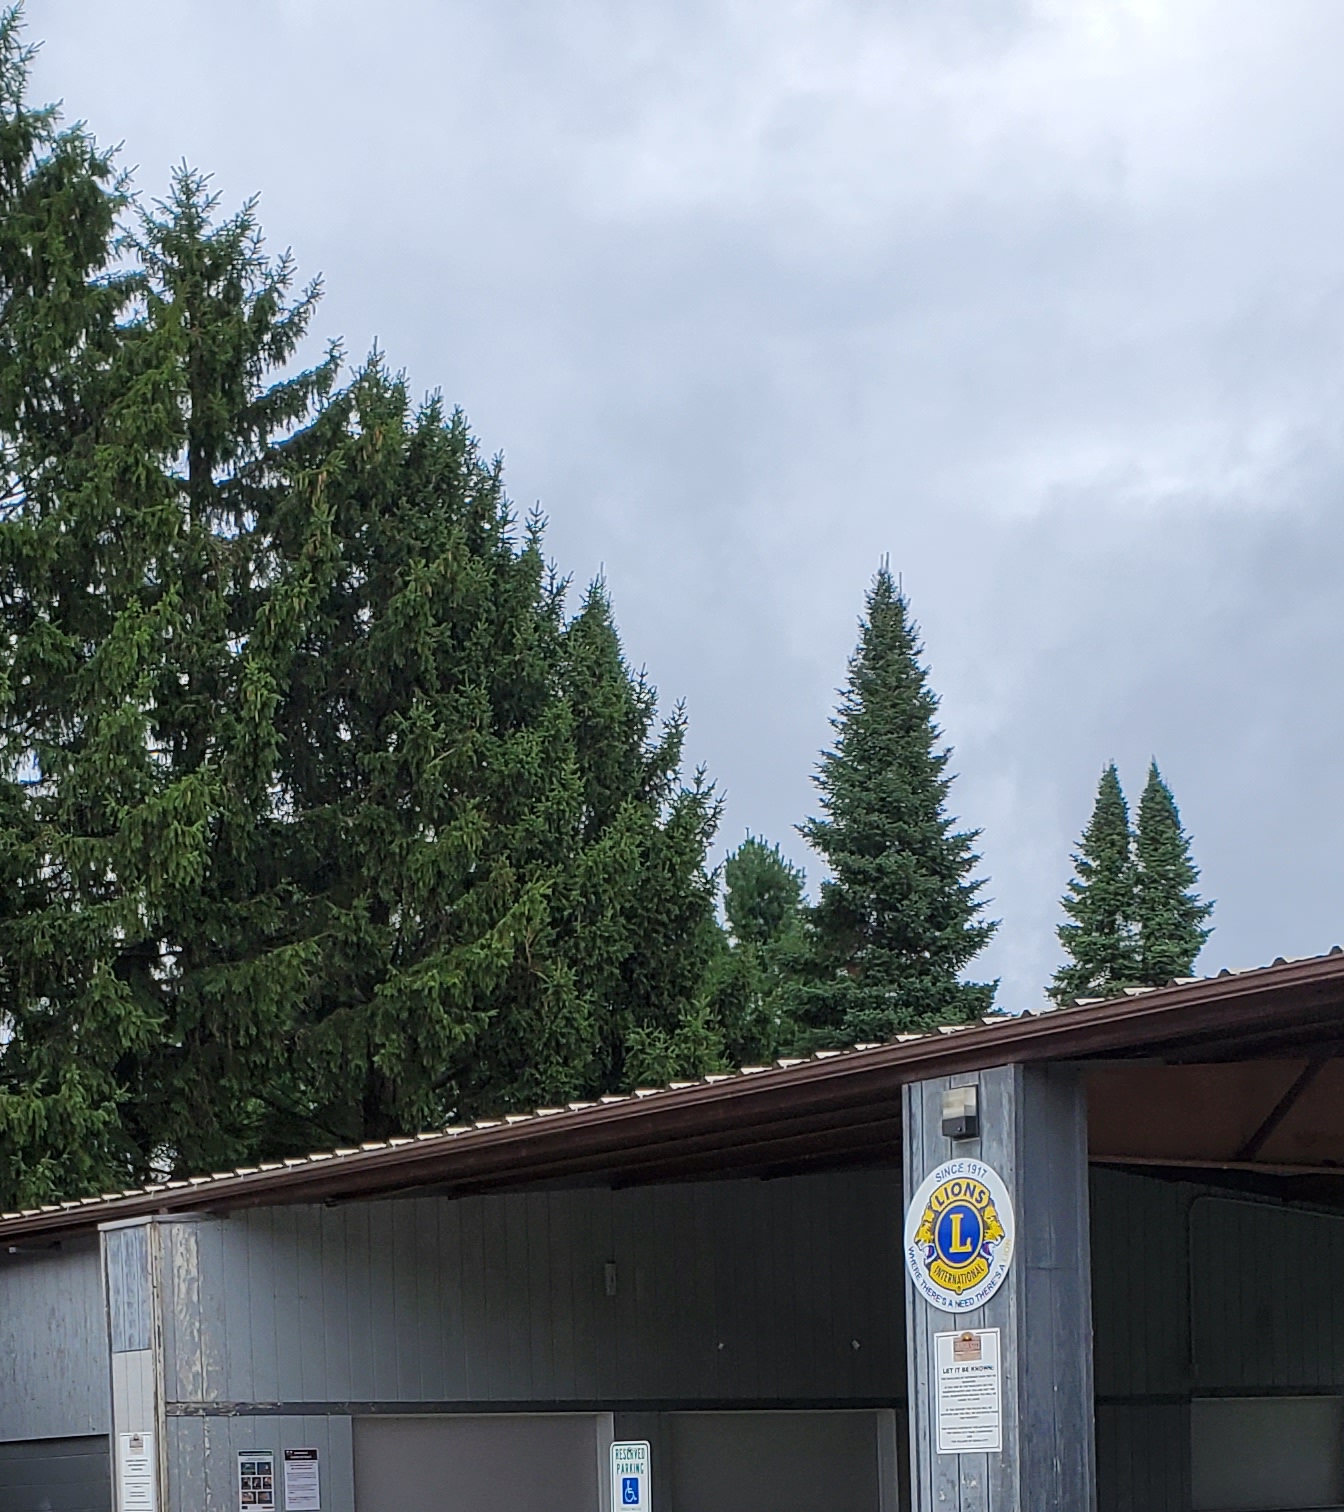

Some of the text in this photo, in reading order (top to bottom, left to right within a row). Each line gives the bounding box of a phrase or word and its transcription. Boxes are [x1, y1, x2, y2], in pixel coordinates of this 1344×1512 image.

[935, 1163, 988, 1182] SINCE 1917
[934, 1182, 986, 1207] LIONS
[949, 1213, 972, 1253] L
[908, 1240, 1012, 1308] WHERE THERE'S A NEED THERE'S A LION
[933, 1263, 985, 1285] INTERNATIONAL
[942, 1367, 954, 1375] LET
[615, 1447, 645, 1460] RESERVED
[616, 1463, 644, 1475] PARKING
